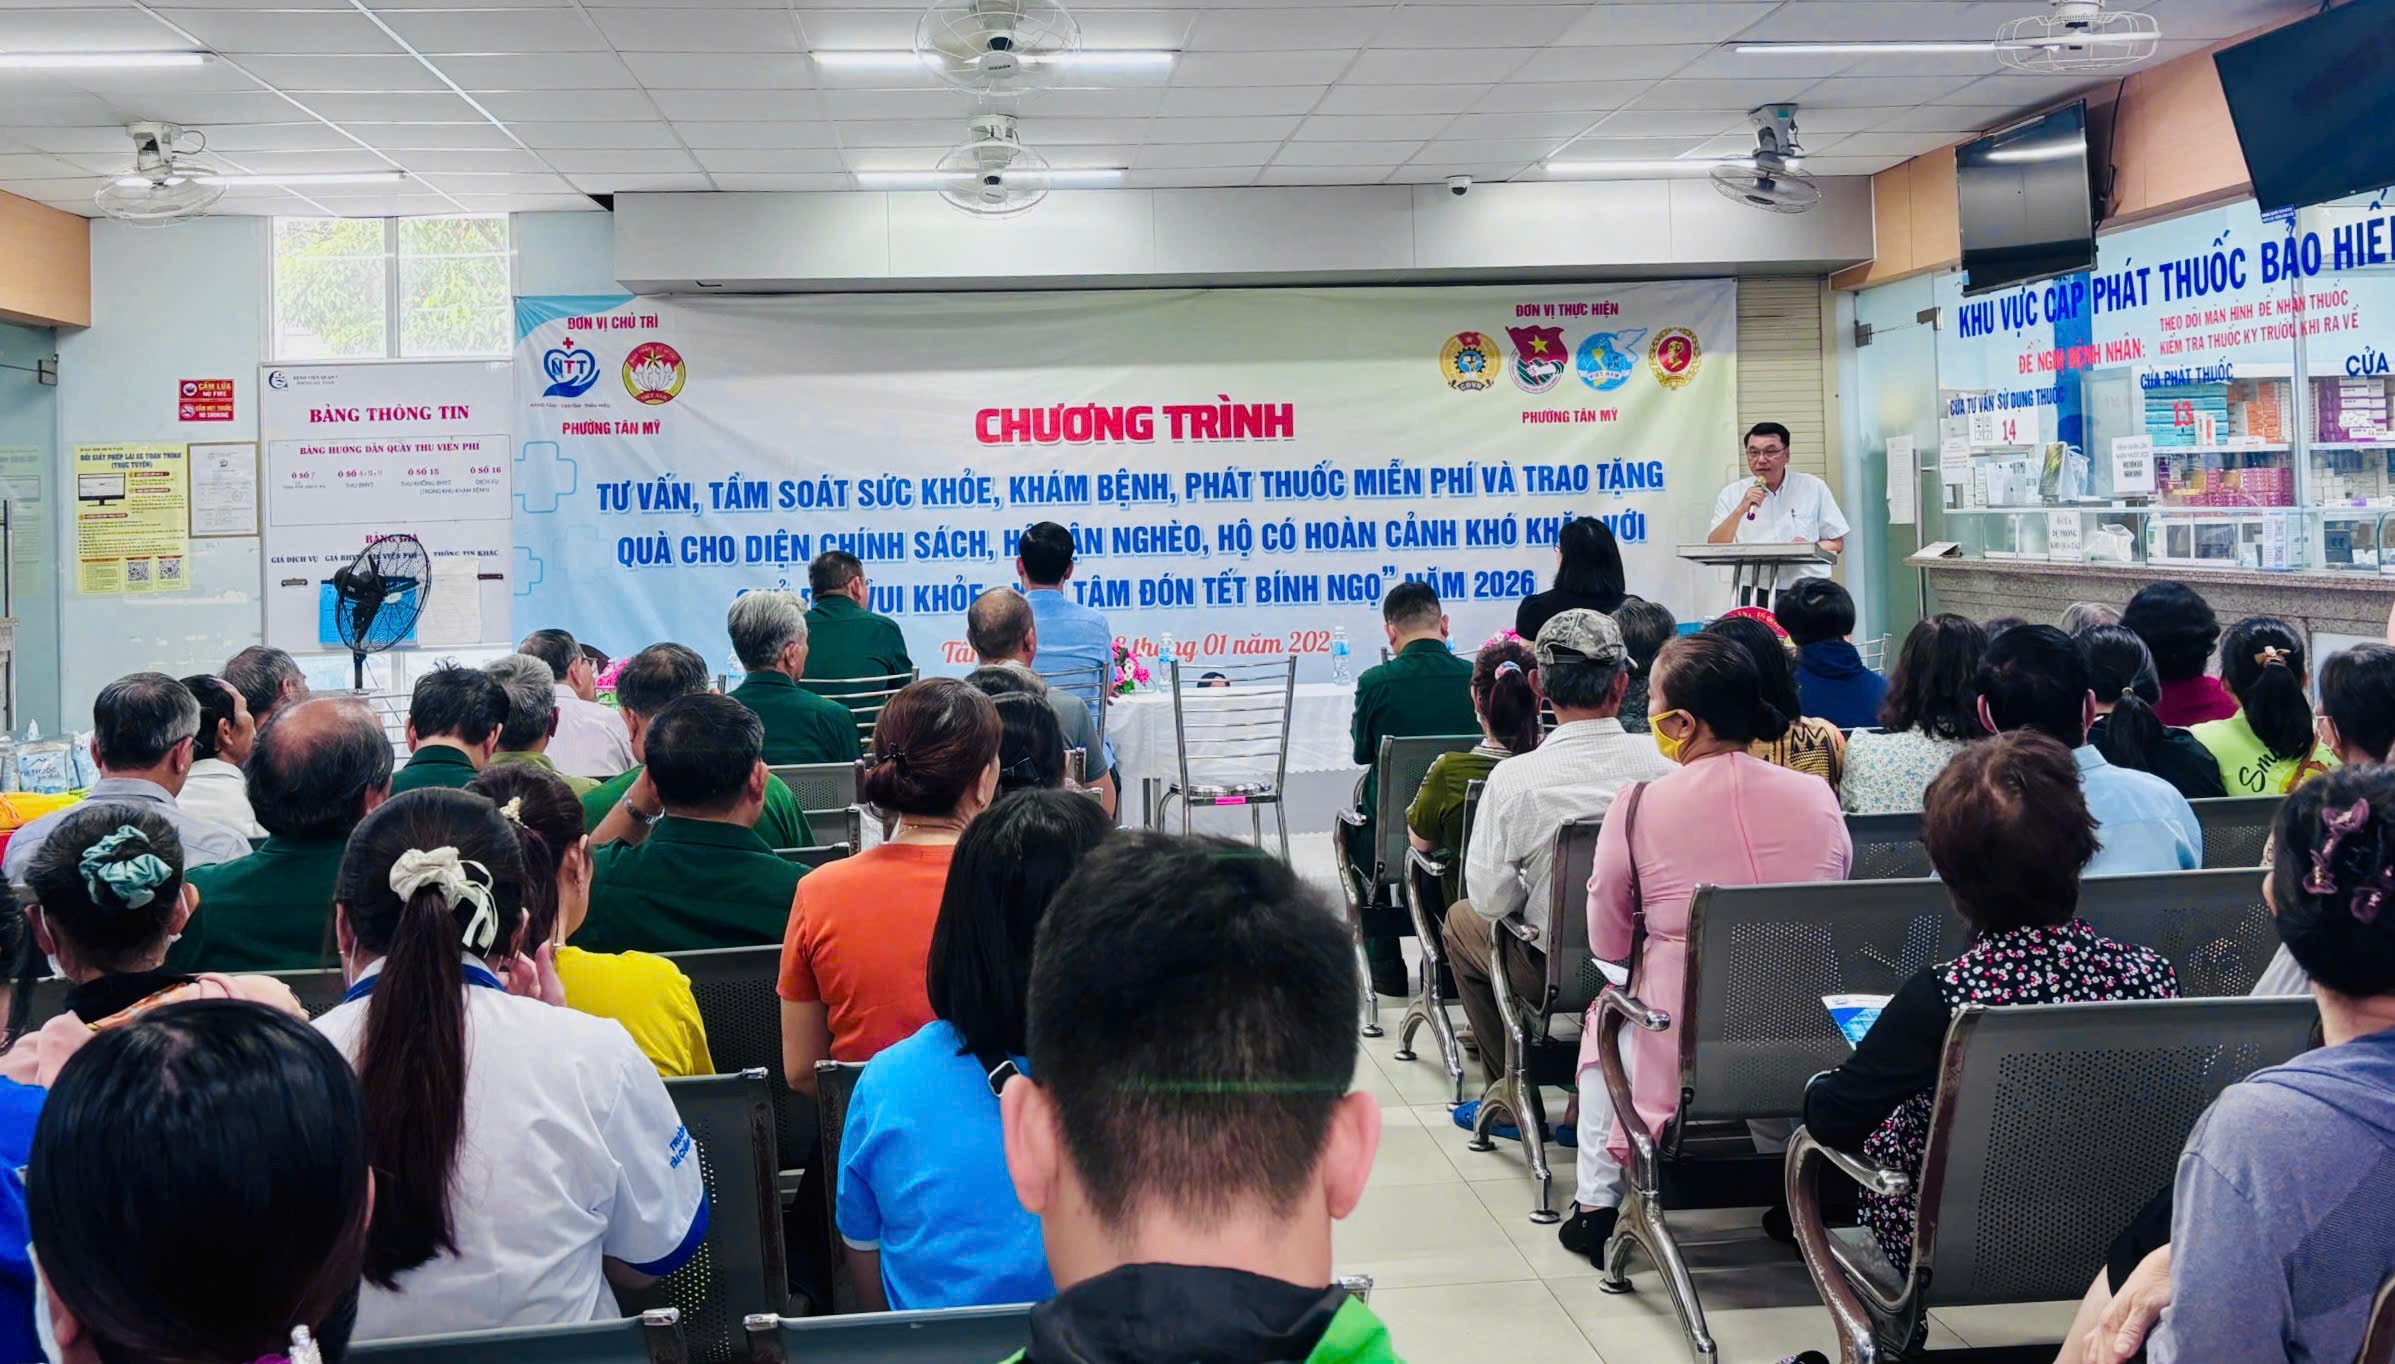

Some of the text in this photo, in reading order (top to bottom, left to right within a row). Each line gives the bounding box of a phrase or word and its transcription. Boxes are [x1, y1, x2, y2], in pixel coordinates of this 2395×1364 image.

[1959, 300, 1994, 338] KHU
[2000, 286, 2038, 338] VỰC
[2093, 257, 2151, 315] PHÁT
[2159, 229, 2246, 302] THUỐC
[2261, 216, 2322, 285] BẢO
[2333, 188, 2395, 271] HIỂ
[1515, 300, 1619, 320] ĐƠN VỊ THỰC HIỆN
[568, 312, 659, 332] ĐƠN VỊ CHỦ TRÌ
[2160, 314, 2183, 332] THEO
[2185, 336, 2205, 353] TRA
[2301, 318, 2320, 336] KHI
[2324, 315, 2340, 333] RA
[552, 358, 587, 377] NTT
[2346, 346, 2390, 376] CỬA
[309, 403, 469, 423] BẢNG THÔNG TIN
[975, 394, 1294, 443] CHƯƠNG TRÌNH
[1522, 408, 1570, 423] PHƯỜNG
[1573, 407, 1596, 423] TÂN
[2173, 400, 2193, 426] 13
[562, 418, 661, 435] PHƯỜNG TÂN MỸ
[2002, 419, 2016, 440] 14
[415, 443, 434, 452] THU
[597, 457, 1664, 513] TƯ VẤN, TẦM SOÁT SỨC KHỎE, KHÁM BỆNH, PHÁT THUỐC MIỄN PHÍ VÀ TRAO TẶNG
[618, 530, 672, 568] QUÀ
[681, 535, 736, 564] CHO
[745, 529, 810, 569] DIỆN
[820, 526, 904, 560] CHÍNH
[914, 525, 994, 561] SÁCH,
[1113, 520, 1209, 555] NGHÈO,
[1218, 518, 1253, 557] HỘ
[1262, 517, 1296, 550] CÓ
[1305, 516, 1376, 549] HOÀN
[1386, 511, 1457, 548] CẢNH
[1466, 512, 1517, 545] KHÓ
[1526, 511, 1574, 545] KHĂ
[1073, 575, 1129, 608] TÂM
[1139, 572, 1193, 606] ĐÓN
[1202, 568, 1247, 604] TẾT
[1256, 569, 1318, 604] BÍNH
[1474, 570, 1535, 598] 2026
[941, 641, 977, 664] Tâ
[1204, 633, 1226, 656] 01
[1233, 632, 1283, 655] năm
[1288, 631, 1331, 653] 202
